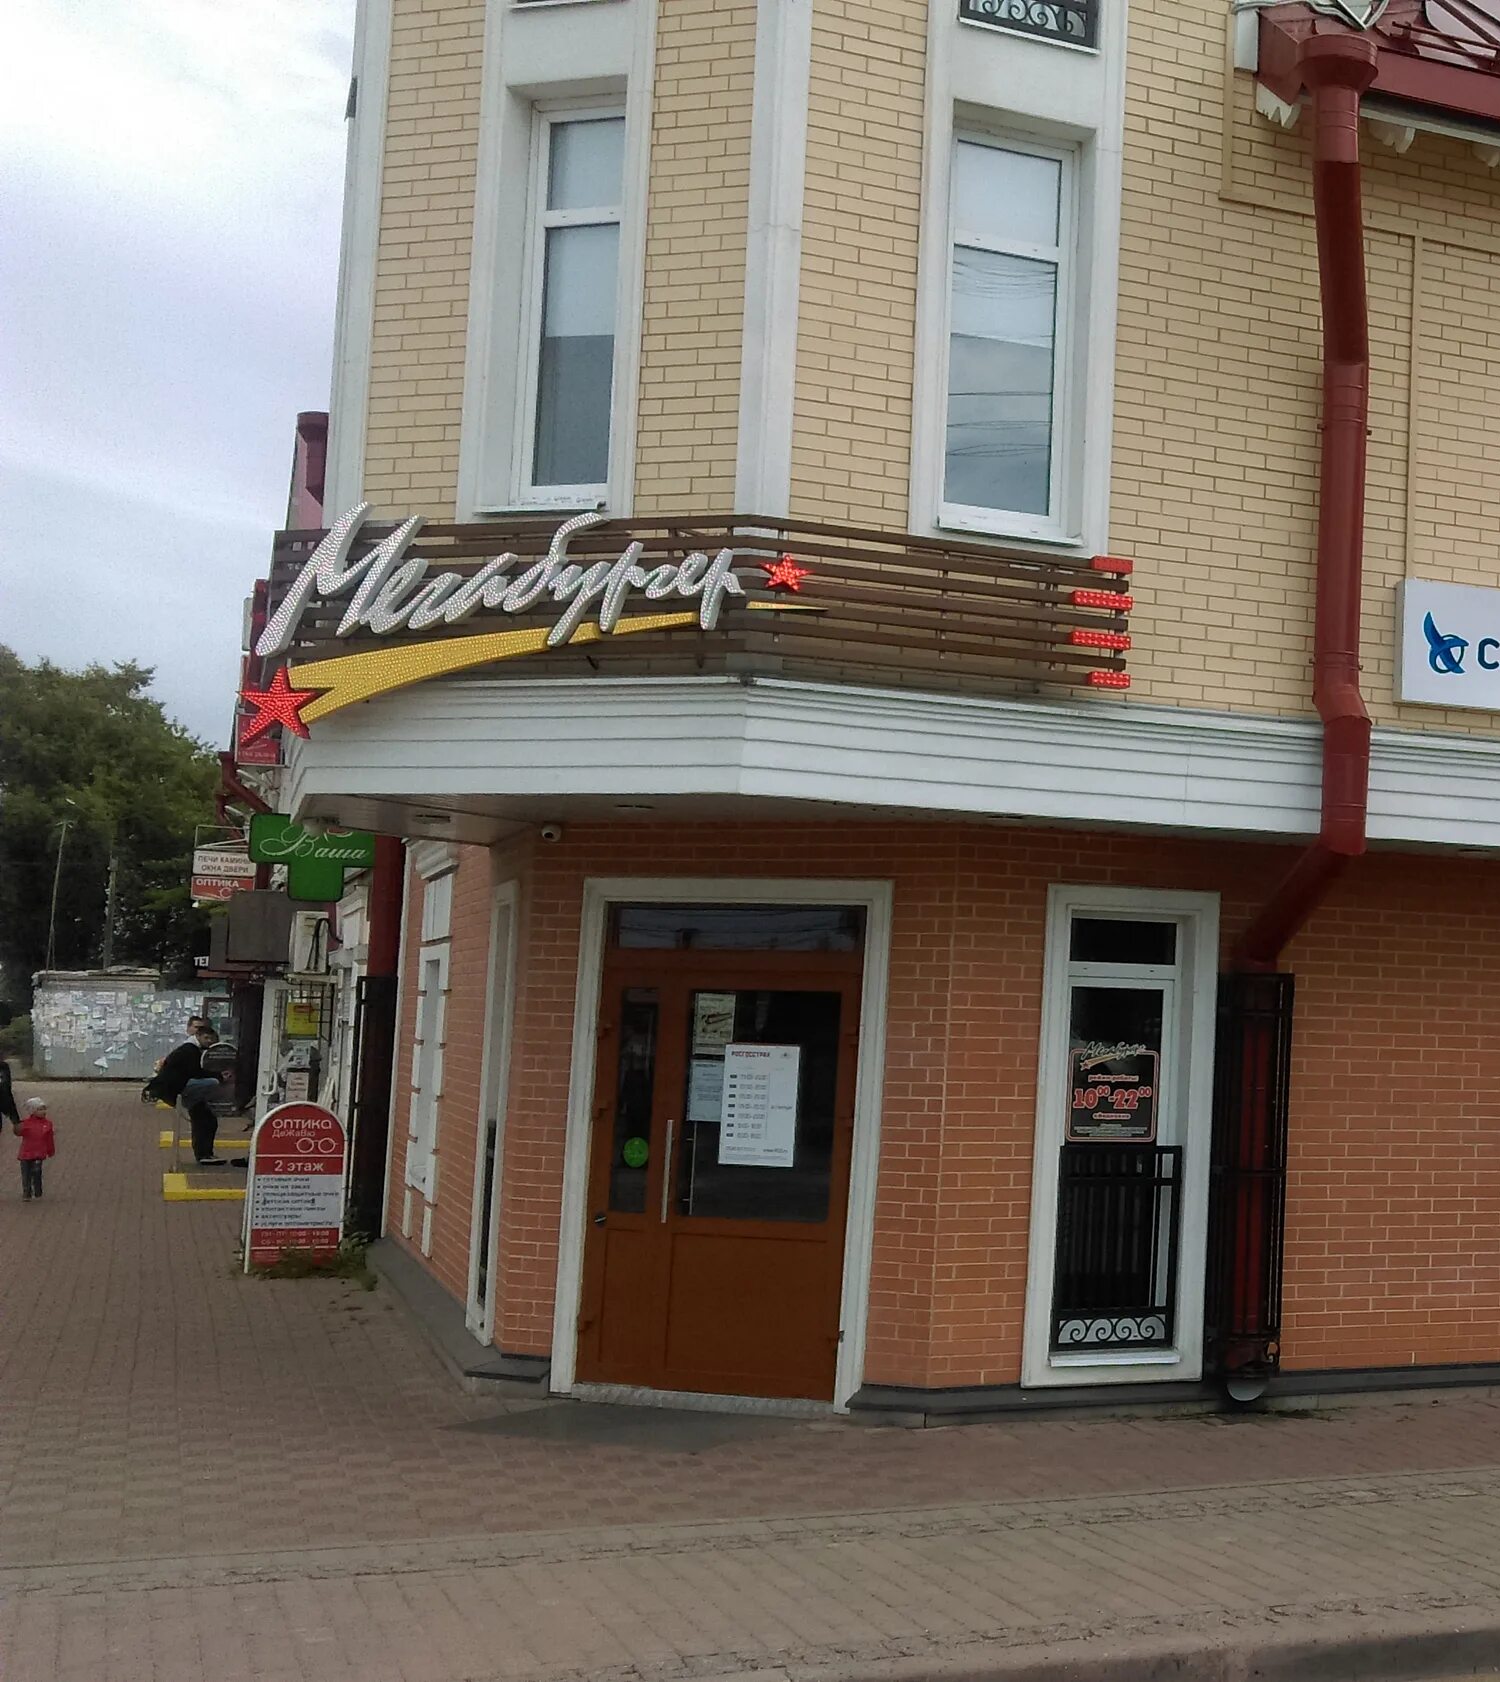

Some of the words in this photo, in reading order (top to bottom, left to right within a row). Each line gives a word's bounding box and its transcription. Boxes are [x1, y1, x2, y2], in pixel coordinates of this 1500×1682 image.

[255, 501, 747, 657] Мегабургер
[260, 825, 369, 860] Ваша
[197, 854, 219, 864] ПЕЧИ
[201, 864, 222, 873] ОКНА
[223, 865, 249, 874] ДВЕРИ
[195, 878, 240, 889] ОПТИКА
[272, 1118, 332, 1130] оптика
[274, 1160, 283, 1172] 2
[287, 1161, 324, 1172] этаж
